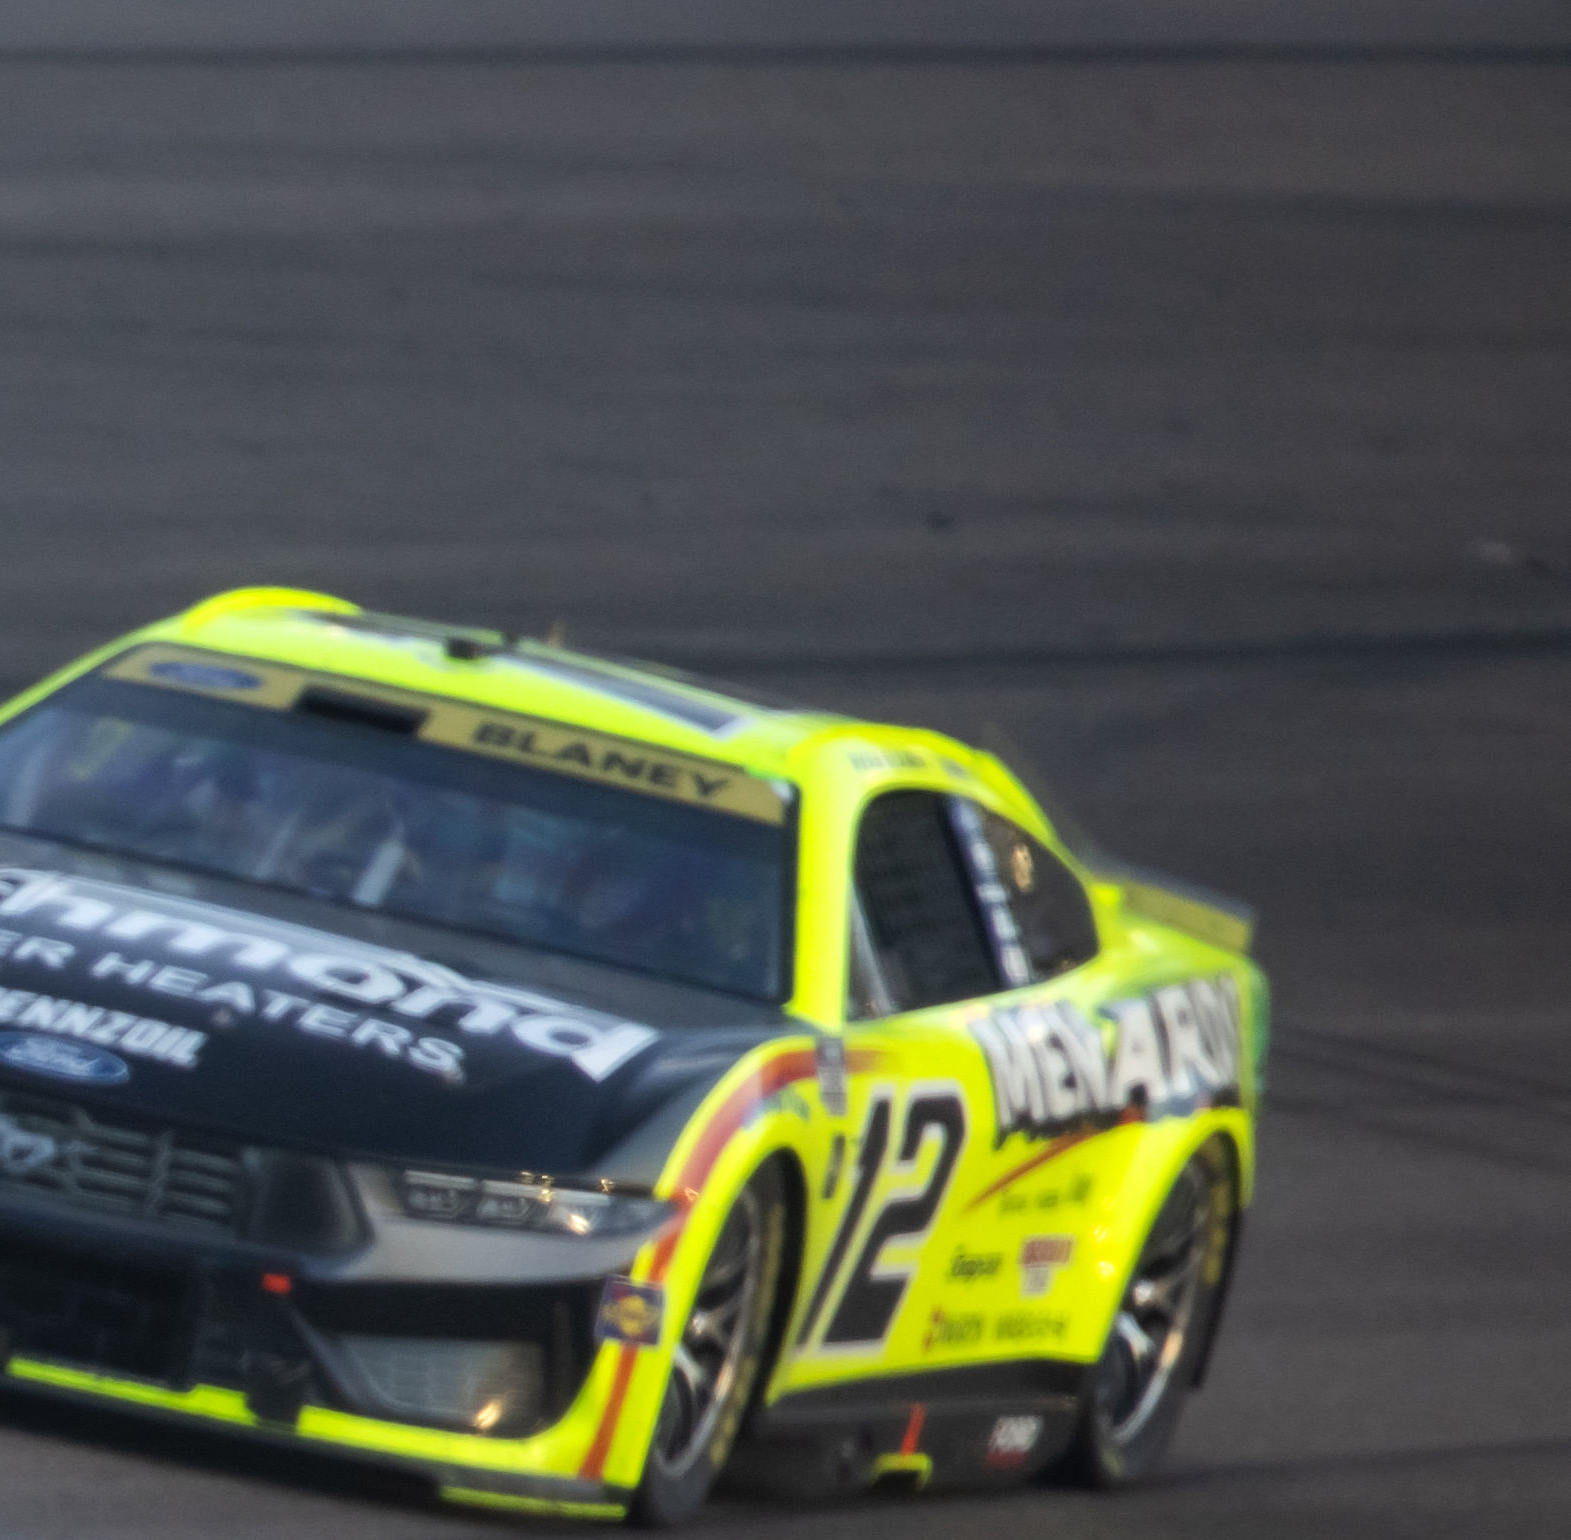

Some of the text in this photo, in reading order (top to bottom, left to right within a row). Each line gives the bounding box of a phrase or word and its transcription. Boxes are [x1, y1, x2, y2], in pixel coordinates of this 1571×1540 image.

[473, 719, 730, 797] BLANEY
[91, 951, 465, 1072] HEATERS
[794, 1088, 967, 1354] 12
